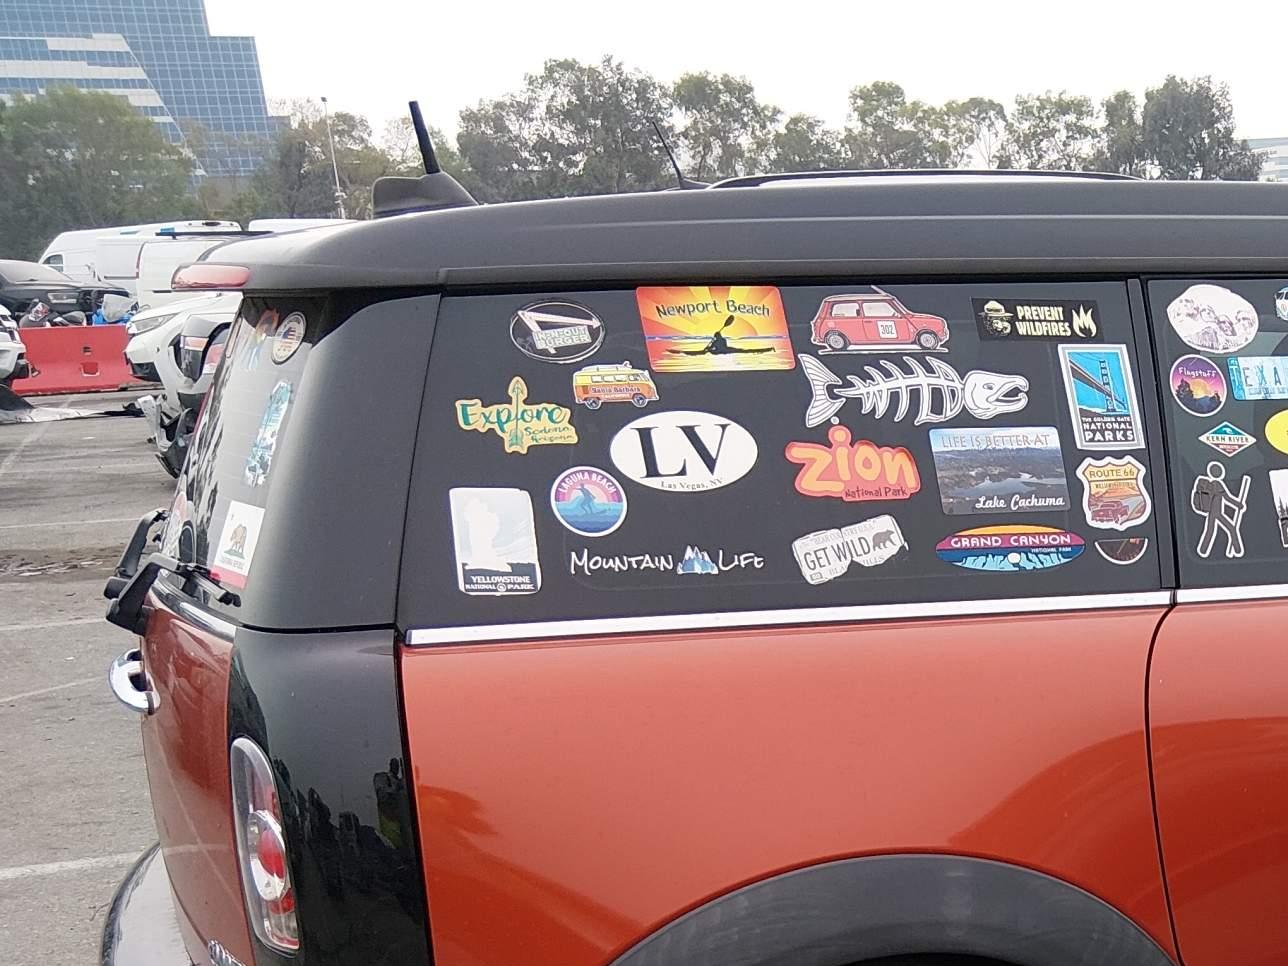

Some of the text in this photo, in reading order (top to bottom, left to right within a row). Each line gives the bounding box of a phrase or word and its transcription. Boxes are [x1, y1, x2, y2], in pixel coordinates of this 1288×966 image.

[656, 299, 770, 317] Newport Beach
[1016, 305, 1064, 320] PREVENT
[535, 327, 587, 340] IN-N-OUT
[880, 324, 895, 335] 302
[1015, 321, 1072, 337] WILDFIRES
[538, 334, 591, 347] BURGER
[1178, 367, 1217, 378] Flagstaff
[460, 402, 567, 434] Explore
[1083, 422, 1132, 430] NATIONAL
[941, 434, 1050, 448] LIFE IS BETTER AT
[1084, 430, 1134, 441] PARKS
[1206, 435, 1226, 443] KERN
[630, 423, 732, 479] LV
[1089, 467, 1135, 479] ROUTE 66
[558, 471, 617, 494] LAGUNA BEACH
[661, 481, 677, 489] Las
[845, 486, 908, 498] National Park
[975, 494, 1066, 511] Lake Cachuma
[950, 534, 1071, 548] GRAND CANYON
[803, 536, 871, 571] GET WILD
[570, 548, 674, 576] MOUNTAIN
[471, 575, 531, 583] YELLOWSTONE
